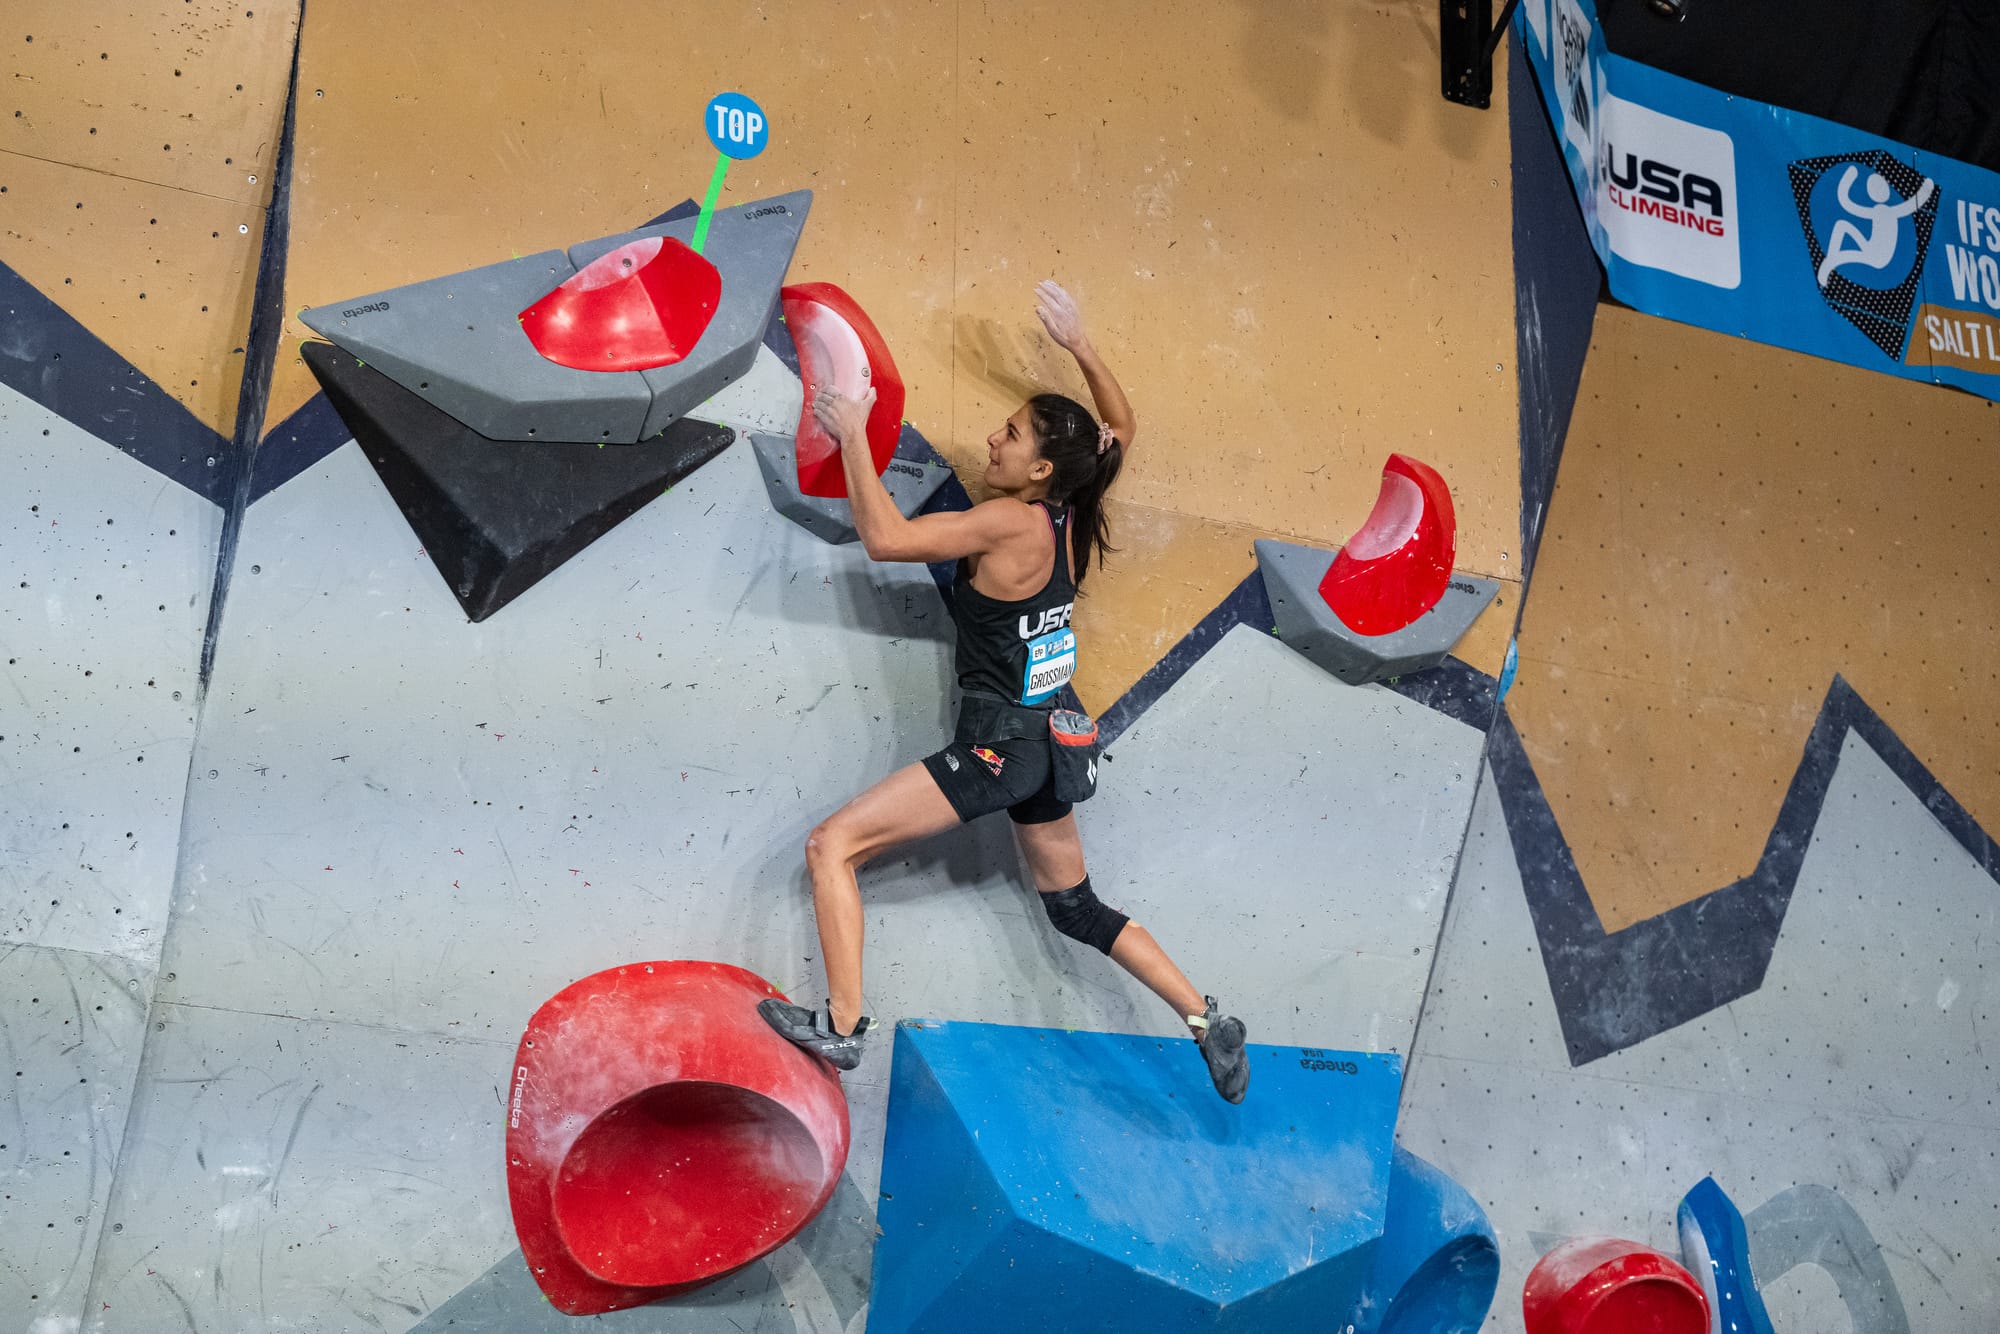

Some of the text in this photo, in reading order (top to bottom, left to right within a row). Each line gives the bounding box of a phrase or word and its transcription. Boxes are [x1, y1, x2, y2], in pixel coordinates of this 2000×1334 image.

[714, 104, 763, 145] TOP
[1608, 142, 1723, 217] USA
[744, 205, 786, 220] Cheeta
[1609, 184, 1724, 237] CLIMBING
[342, 301, 390, 318] Cheeta
[1925, 314, 2000, 361] SALT L
[1030, 661, 1074, 690] GROSSMAN
[1300, 1058, 1358, 1076] Cheeta
[511, 1066, 528, 1129] Cheeta
